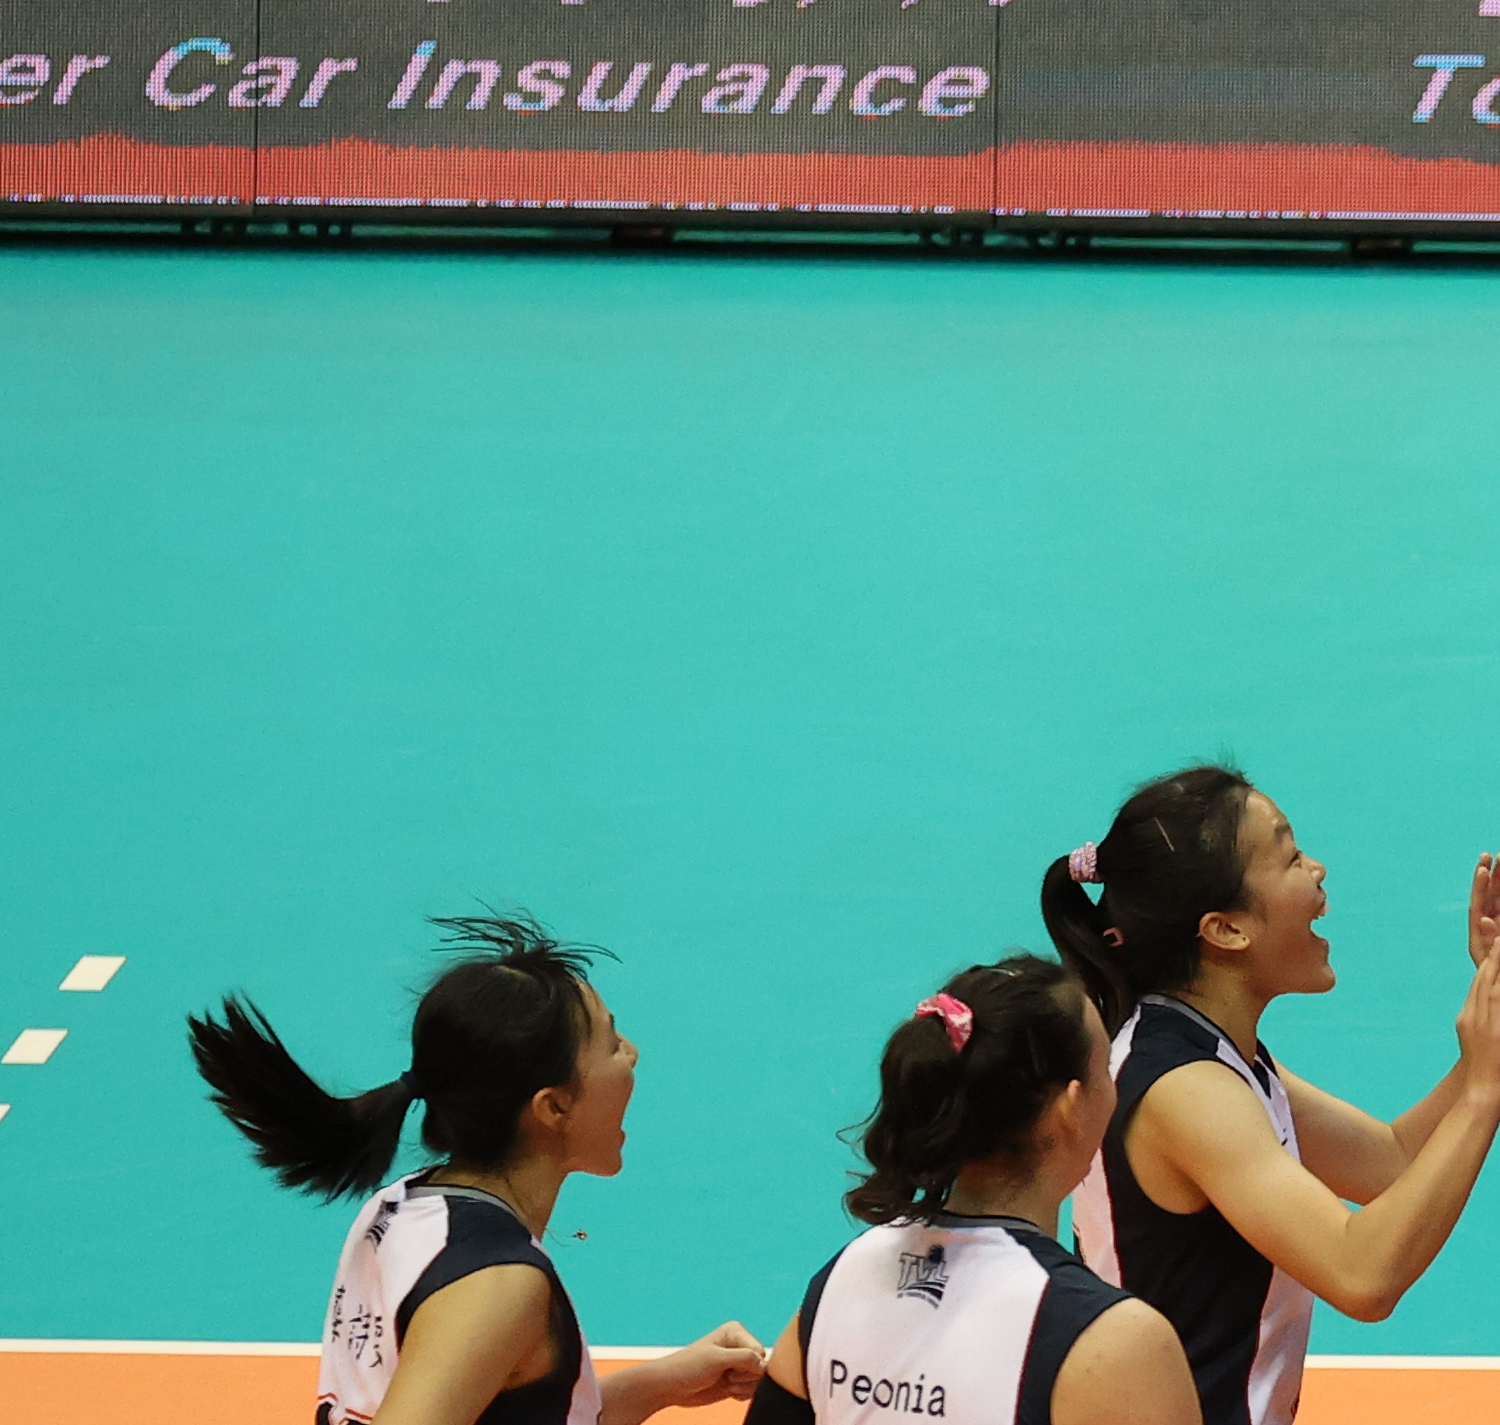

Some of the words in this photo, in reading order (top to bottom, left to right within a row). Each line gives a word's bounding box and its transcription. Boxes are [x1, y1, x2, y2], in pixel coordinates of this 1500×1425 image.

[145, 36, 358, 112] Car
[387, 39, 992, 120] Insurance
[828, 1359, 946, 1417] Peonia
